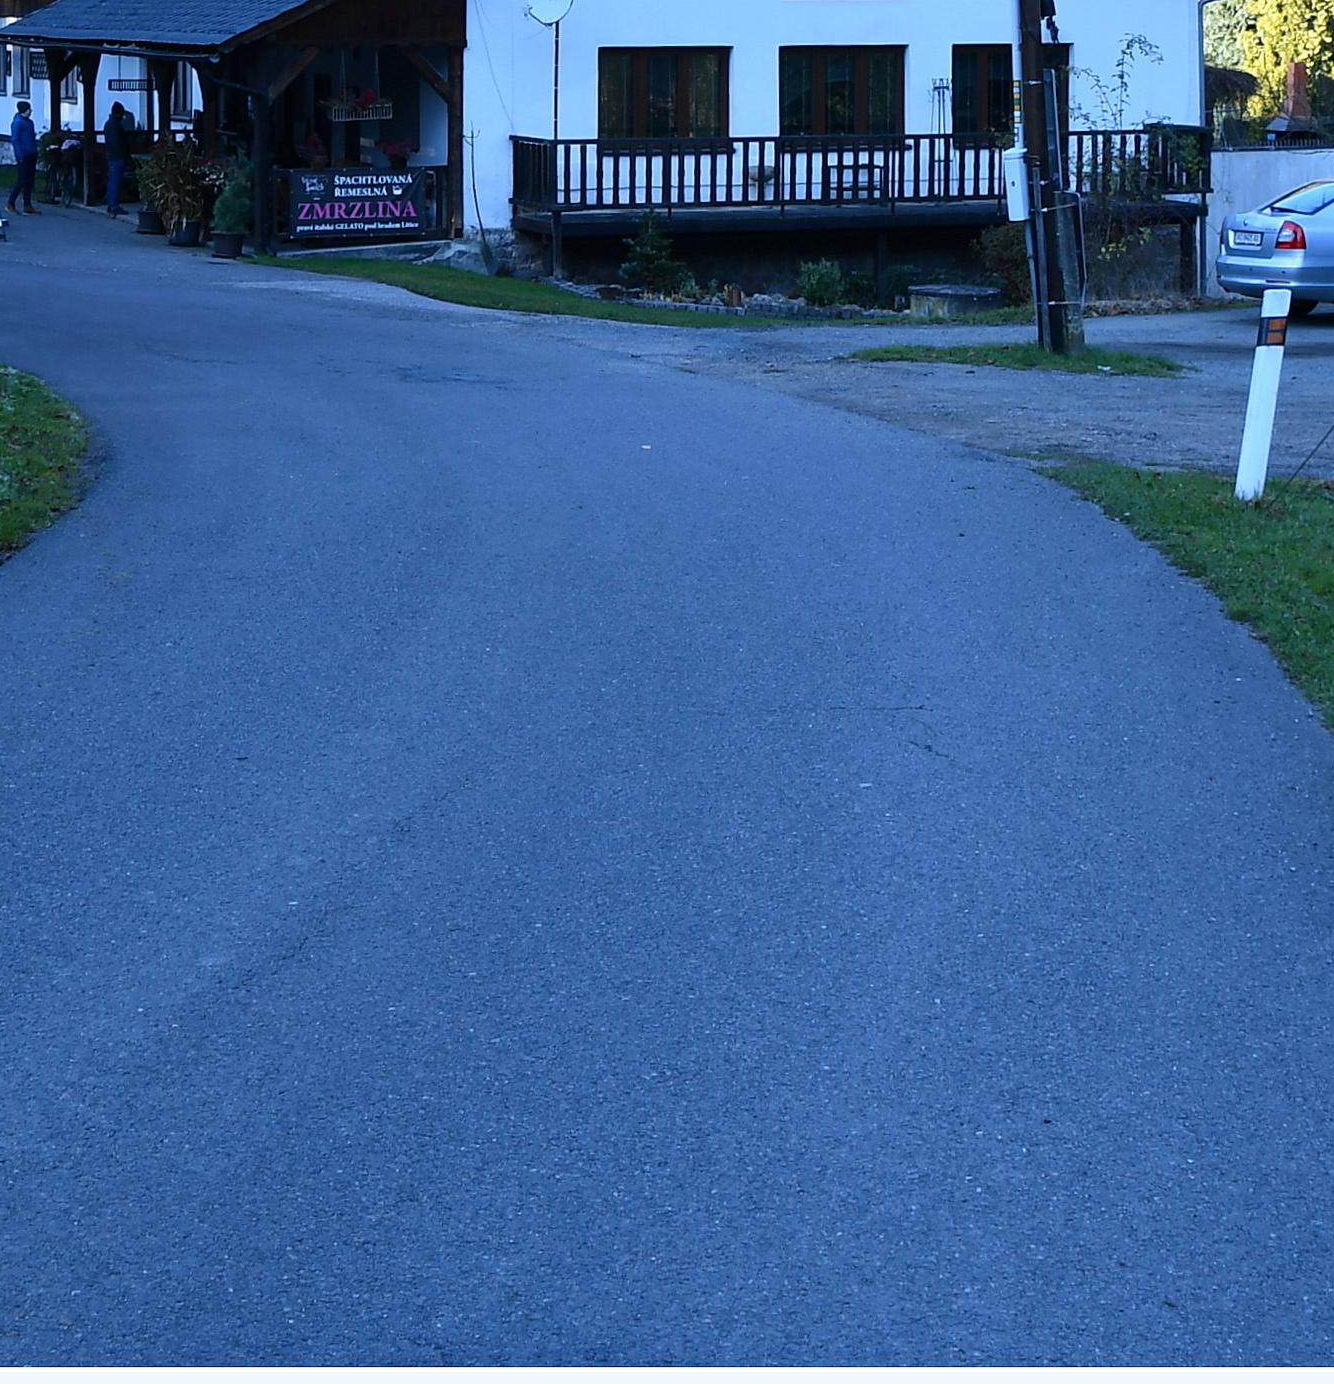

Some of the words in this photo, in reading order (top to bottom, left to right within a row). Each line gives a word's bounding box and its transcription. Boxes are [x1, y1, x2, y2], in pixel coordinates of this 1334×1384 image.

[334, 174, 413, 185] ŠPACHTLOVANÁ
[334, 186, 387, 197] ŘEMESLNÁ
[298, 200, 418, 220] ZMRZLINA
[335, 222, 364, 230] GELATO
